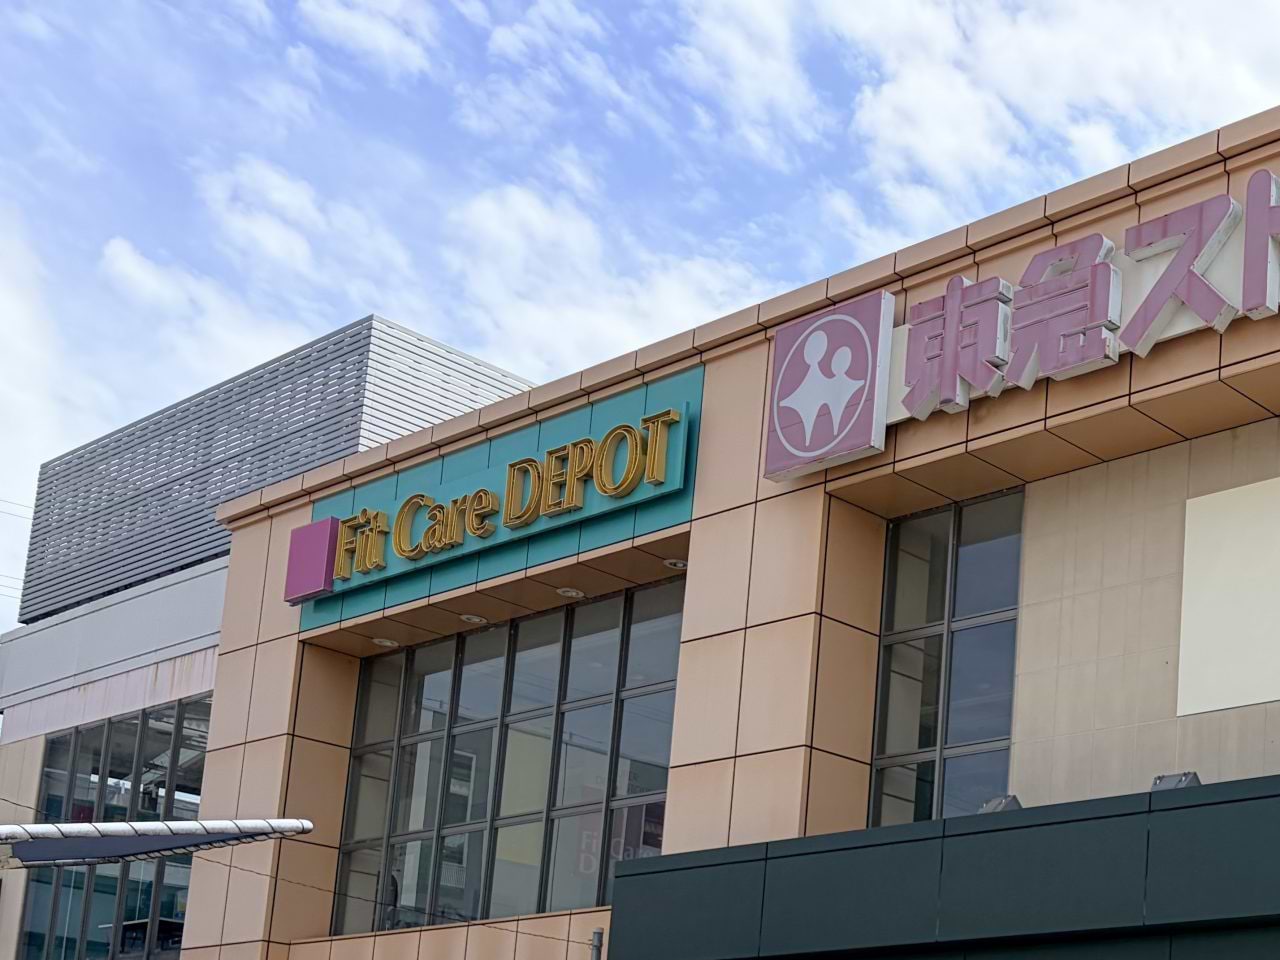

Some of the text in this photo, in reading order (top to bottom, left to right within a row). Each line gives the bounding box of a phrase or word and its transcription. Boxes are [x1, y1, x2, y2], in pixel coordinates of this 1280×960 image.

[333, 408, 680, 580] Fit Care DEPOT
